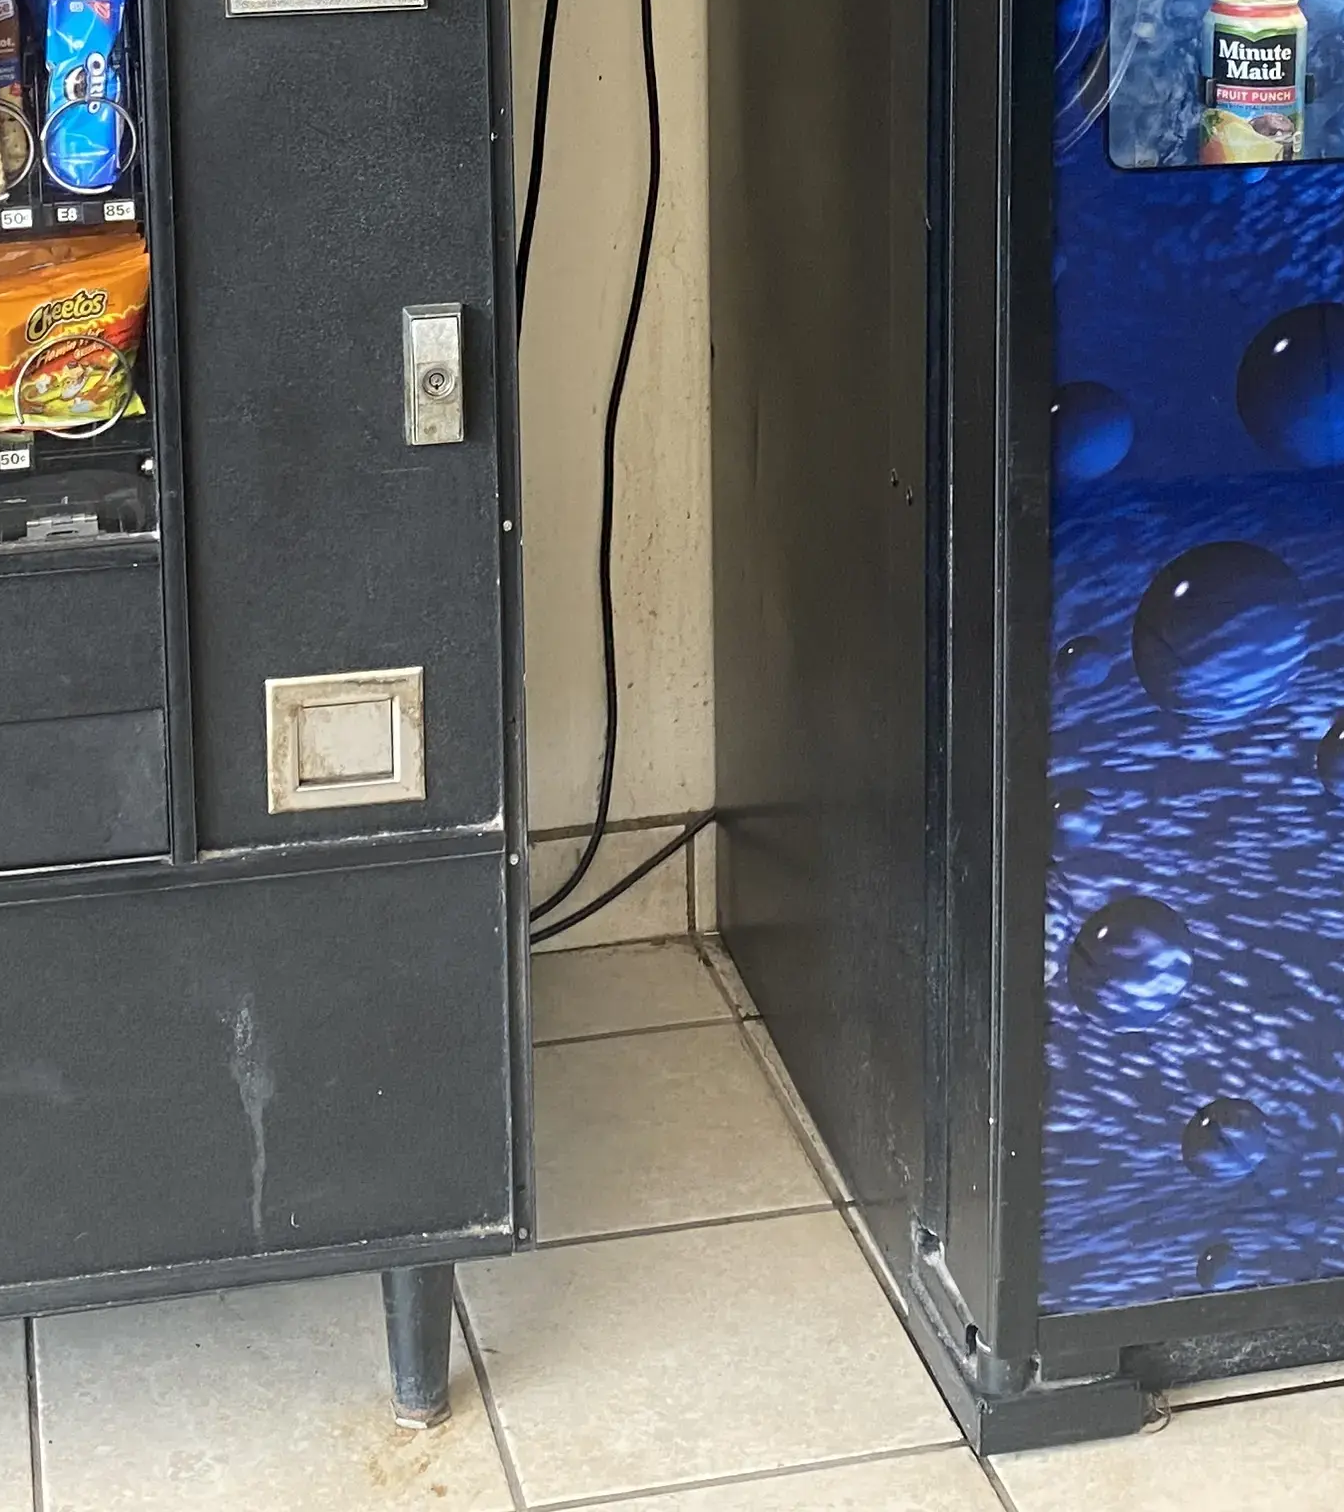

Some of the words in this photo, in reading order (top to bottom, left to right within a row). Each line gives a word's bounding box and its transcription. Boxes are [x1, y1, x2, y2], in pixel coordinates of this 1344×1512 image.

[1218, 39, 1292, 62] Minute
[1226, 60, 1282, 81] Maid
[1217, 88, 1248, 101] FRUIT
[1252, 90, 1291, 102] PUNCH
[57, 208, 78, 222] E8
[28, 290, 106, 340] Cheetos
